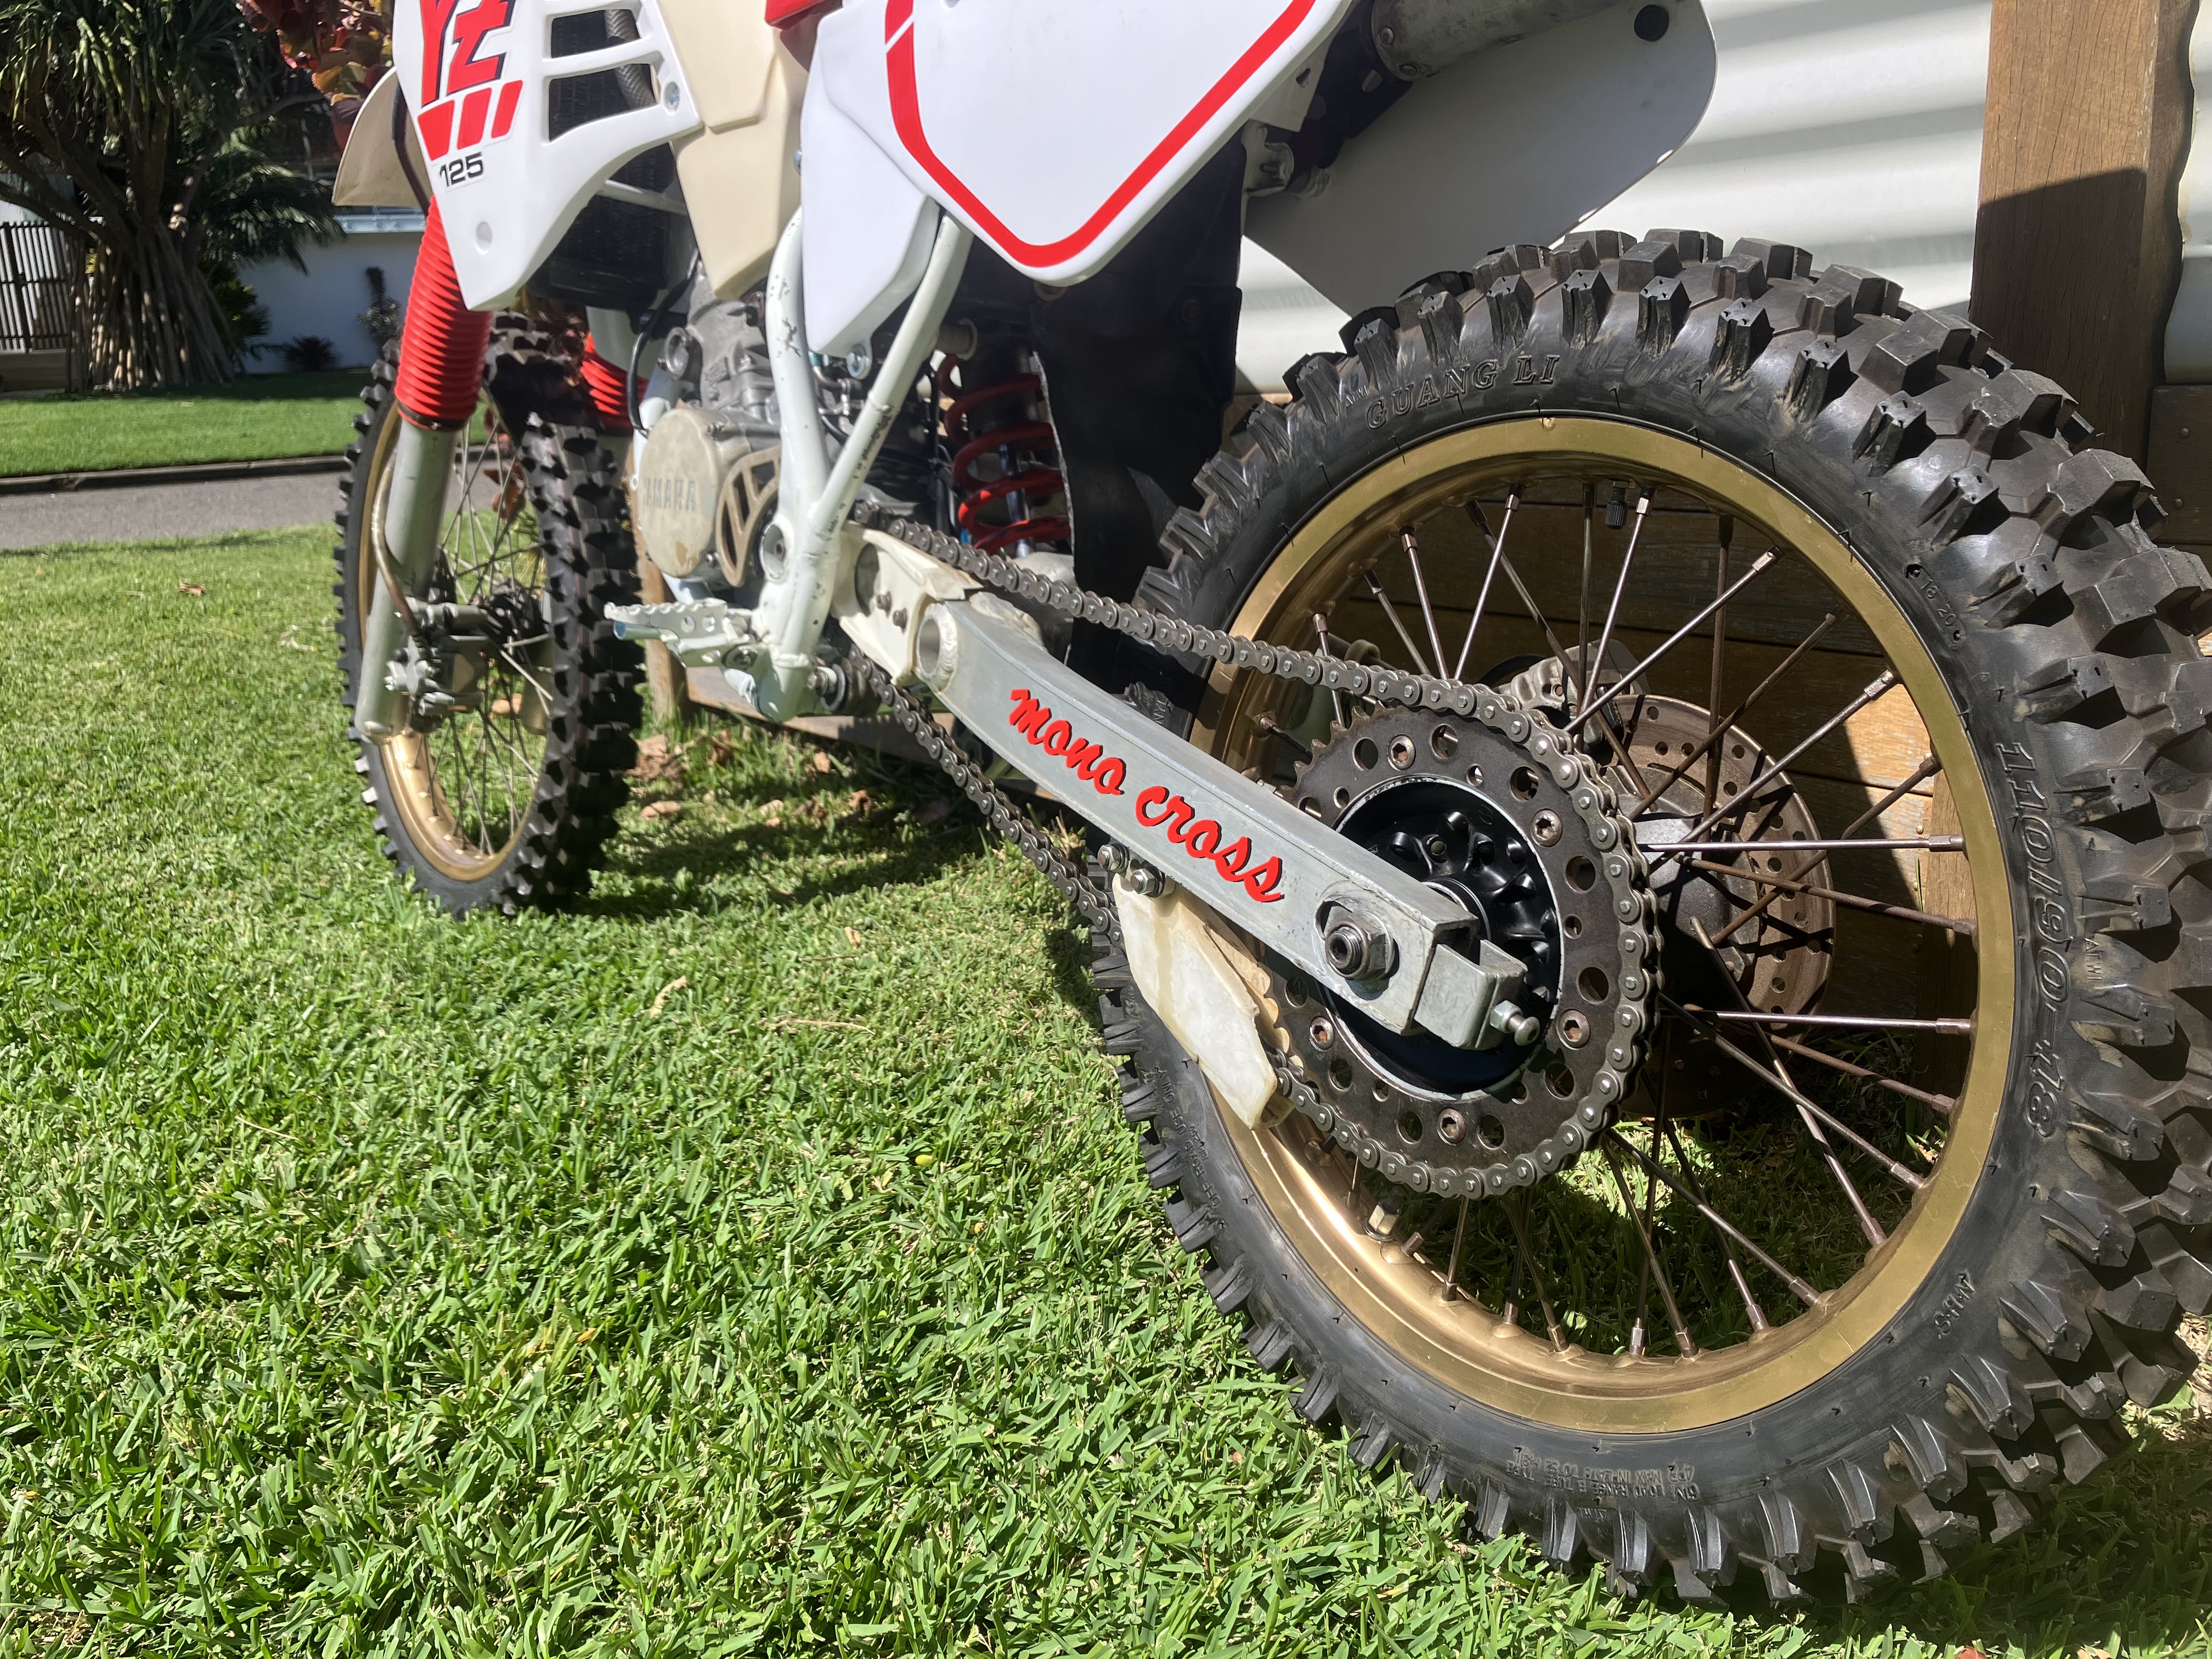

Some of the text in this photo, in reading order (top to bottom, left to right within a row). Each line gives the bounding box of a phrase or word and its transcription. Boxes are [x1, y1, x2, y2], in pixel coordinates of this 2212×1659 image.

[438, 151, 485, 187] 125
[1368, 354, 1561, 429] GUANG LI
[1008, 688, 1285, 904] mono cross
[1169, 1107, 1187, 1136] USE
[1506, 1460, 1536, 1482] TYPE
[1563, 1463, 1579, 1479] TO
[1584, 1466, 1631, 1483] INFLATE
[1635, 1468, 1663, 1483] MAX
[1592, 1481, 1629, 1499] RANGE
[1633, 1483, 1665, 1499] LOAD
